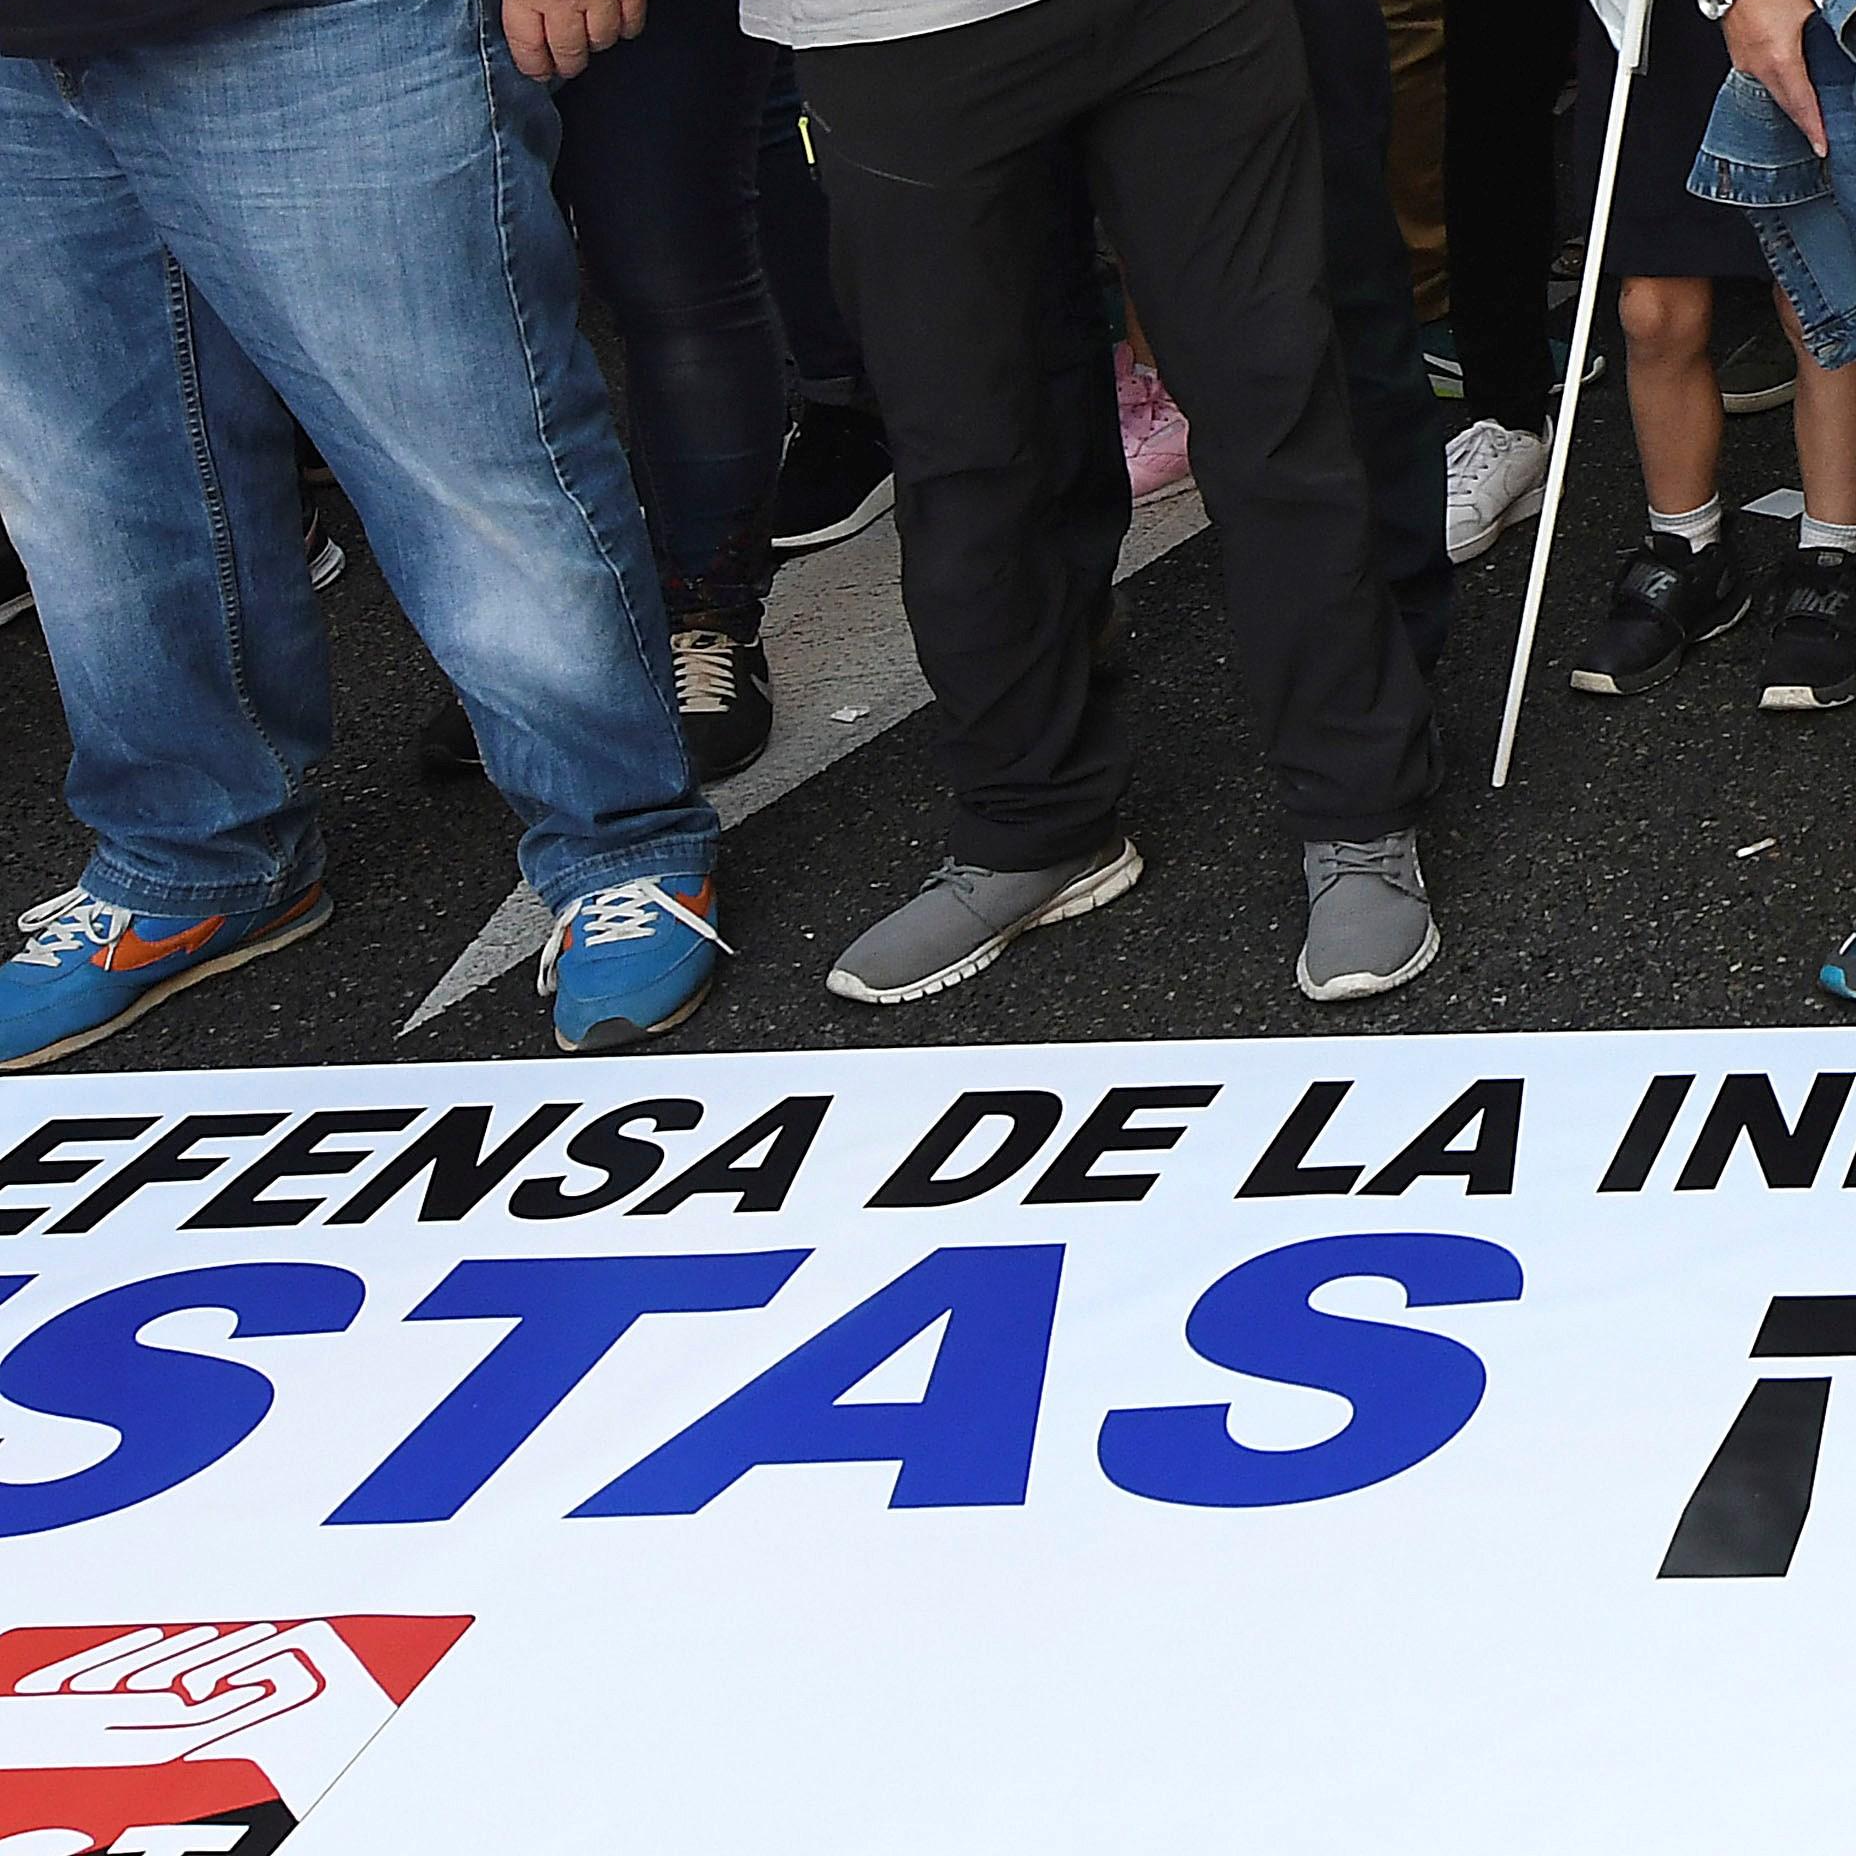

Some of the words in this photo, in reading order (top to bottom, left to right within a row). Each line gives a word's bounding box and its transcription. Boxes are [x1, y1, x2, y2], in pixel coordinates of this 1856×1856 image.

[865, 1083, 1222, 1209] DE
[1235, 1077, 1525, 1199] LA
[0, 1233, 1525, 1538] STAS
